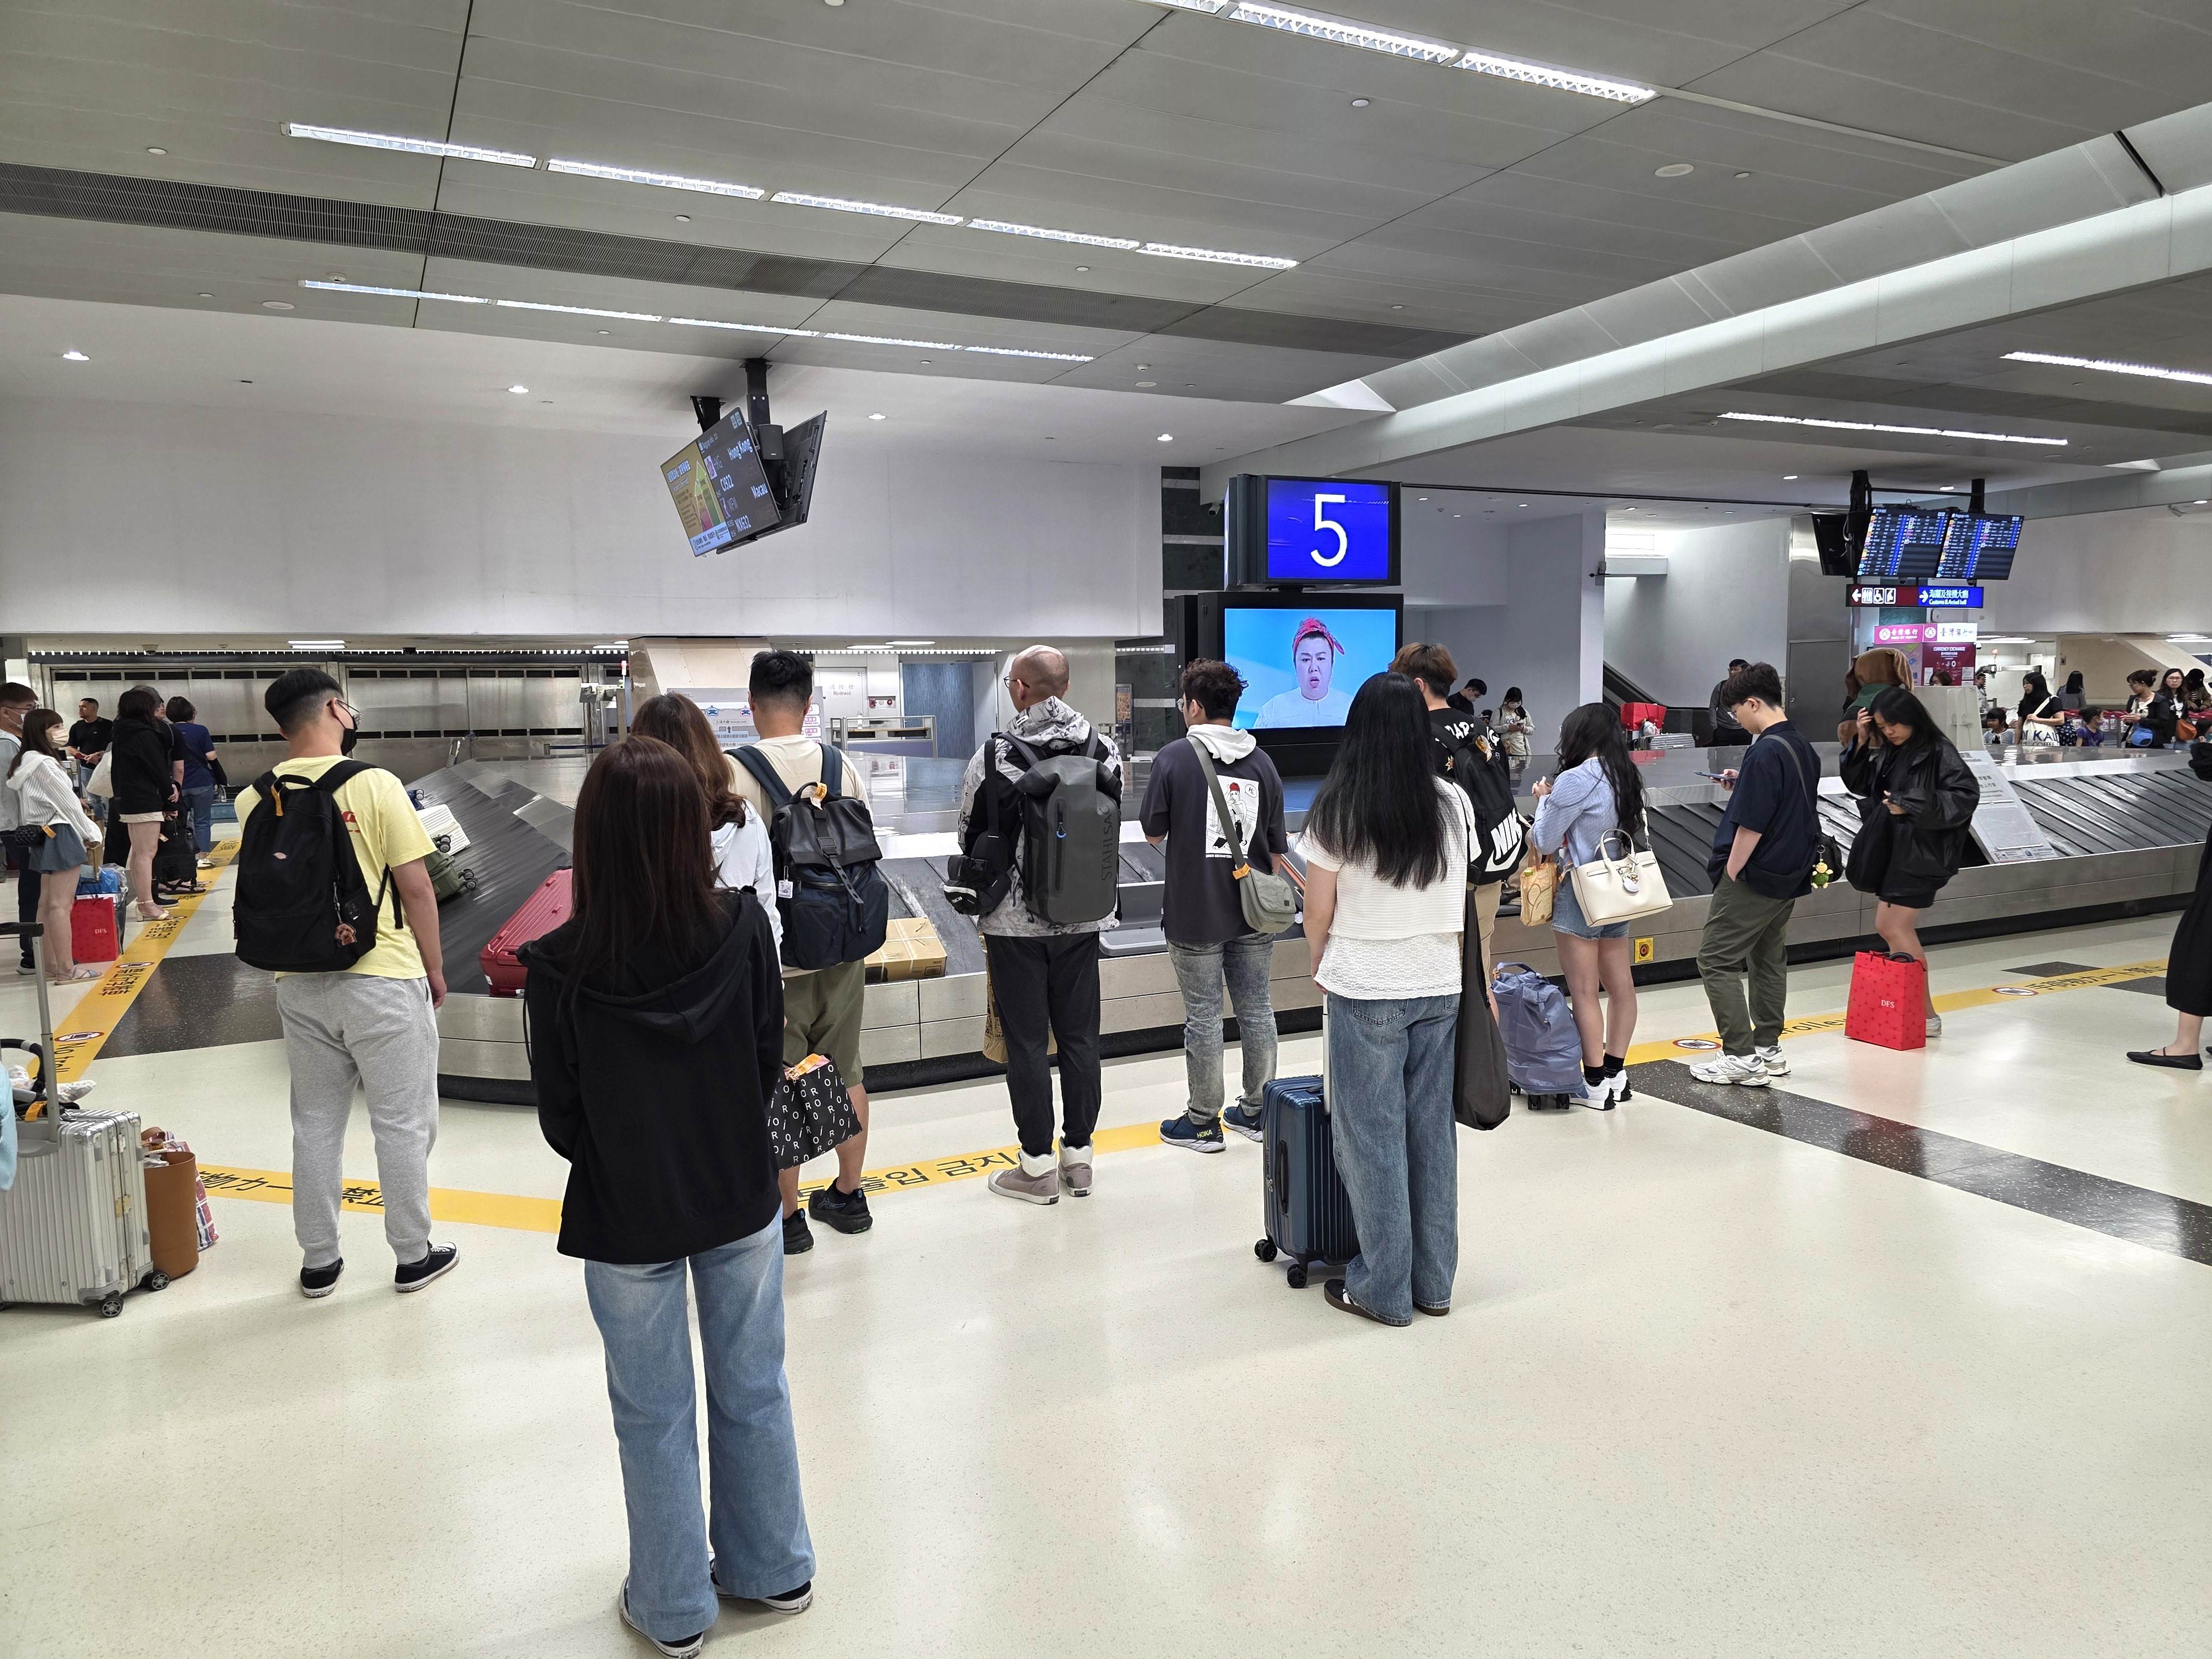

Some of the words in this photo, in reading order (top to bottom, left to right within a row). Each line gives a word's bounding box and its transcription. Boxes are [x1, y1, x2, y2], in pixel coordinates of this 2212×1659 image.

[727, 446, 742, 461] Hong
[738, 439, 753, 453] Kong
[751, 483, 768, 499] Macau
[1311, 494, 1348, 567] 5
[1099, 805, 1113, 881] STAHLSAC
[1881, 999, 1895, 1009] DFS
[55, 1042, 88, 1055] No
[937, 1152, 1018, 1177] 금지
